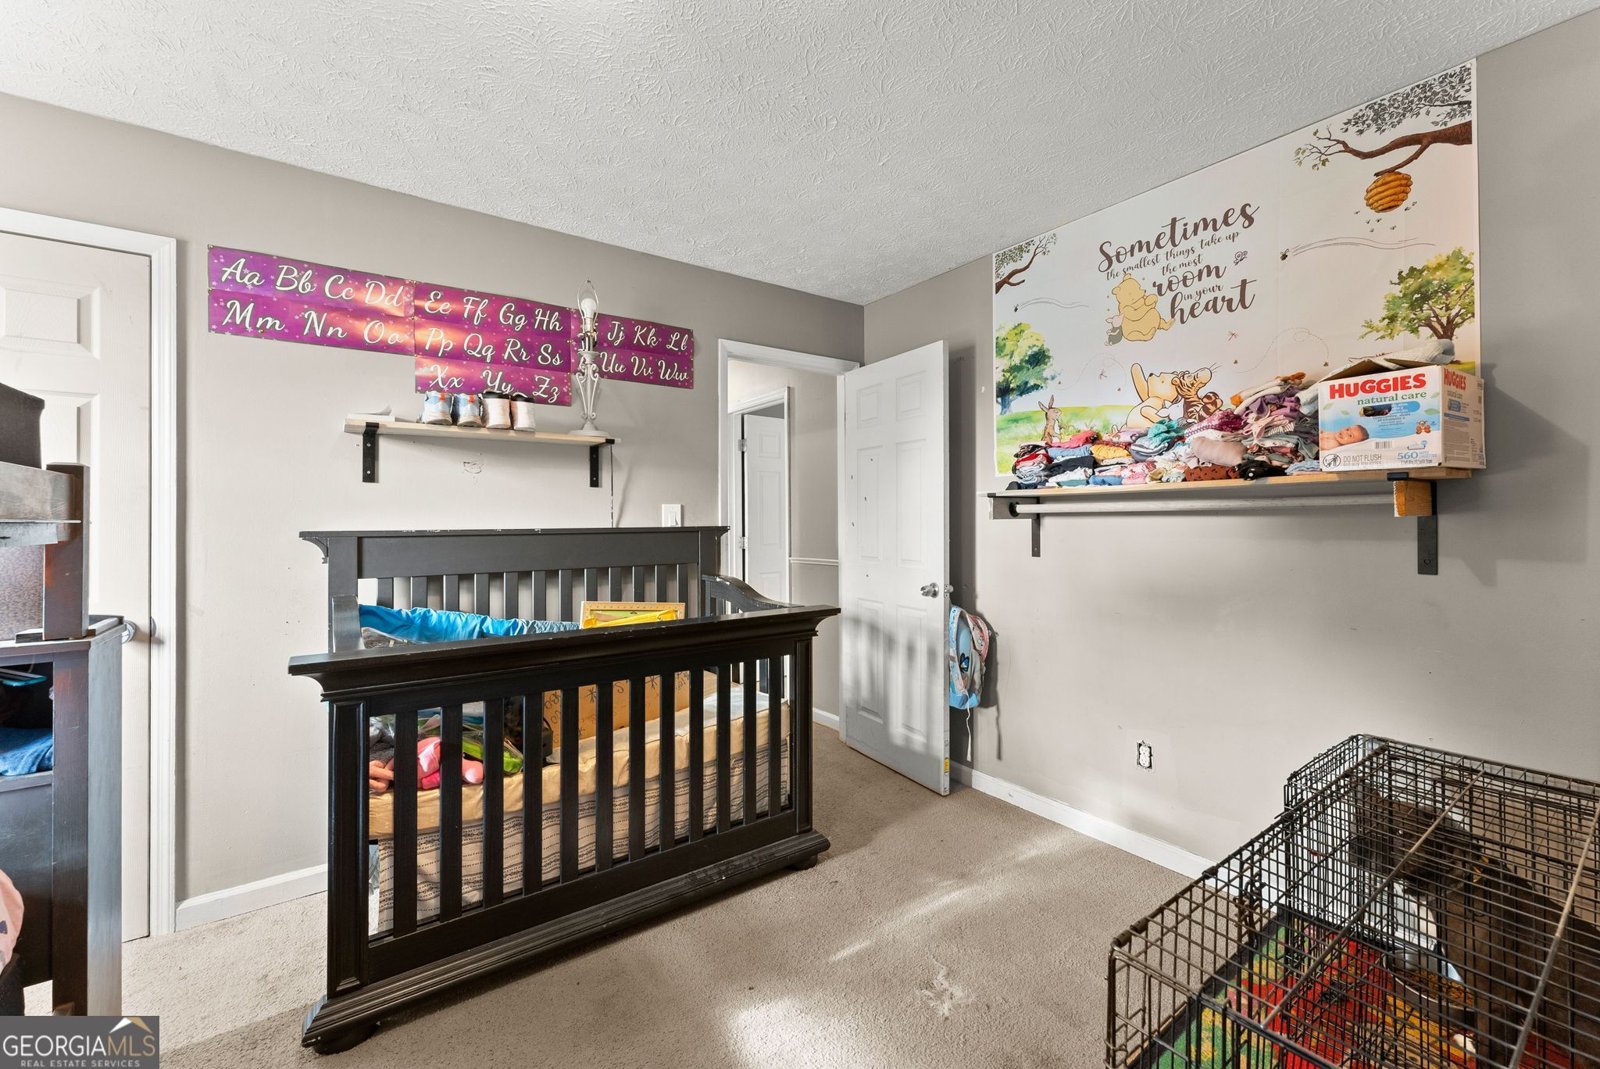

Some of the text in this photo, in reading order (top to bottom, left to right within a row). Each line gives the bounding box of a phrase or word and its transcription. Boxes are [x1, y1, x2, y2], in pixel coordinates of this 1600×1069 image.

[1098, 203, 1260, 272] Sometimes
[1106, 231, 1240, 281] the smallest things take up
[1162, 253, 1203, 276] the most
[221, 258, 404, 307] Aa Bb Cc Dd
[1152, 264, 1227, 297] room
[1184, 283, 1223, 301] in your
[424, 290, 563, 333] Ee Ff Gg Hh
[1170, 278, 1257, 325] heart
[222, 299, 404, 344] Mm Nn Oo
[607, 321, 689, 351] Jj Kk Ll
[424, 328, 564, 367] Pp Qq Rr Ss
[600, 352, 690, 382] Uu Vv Ww
[1443, 367, 1467, 391] HUGGIES
[429, 364, 561, 404] Xx Yy Zz
[1329, 373, 1427, 400] HUGGIES
[1357, 390, 1427, 406] natural care
[1397, 451, 1418, 460] 560
